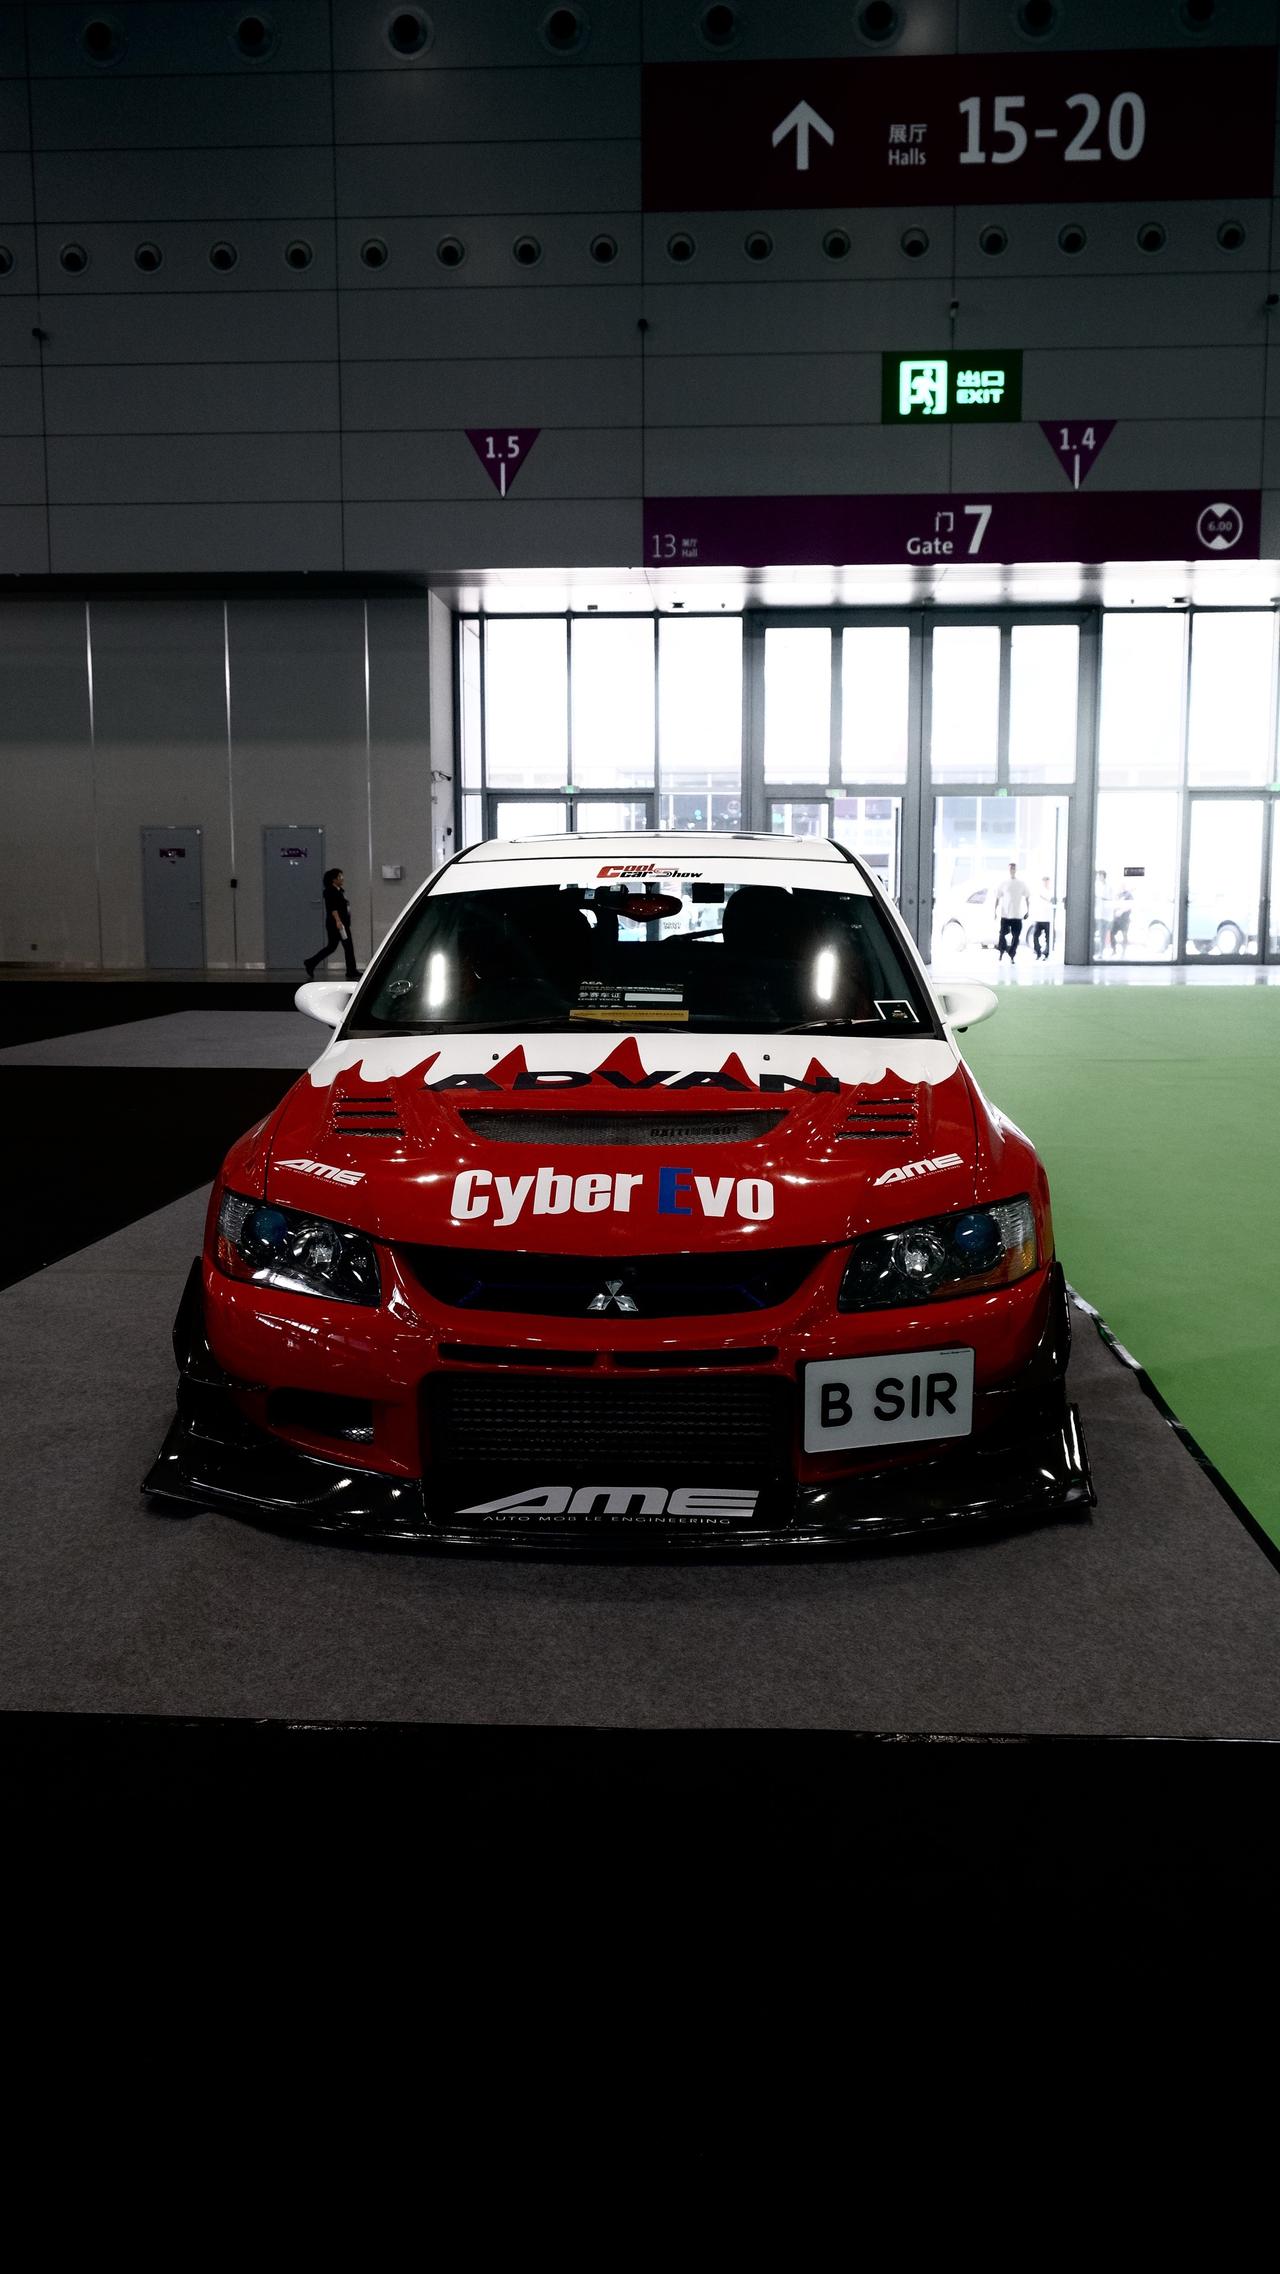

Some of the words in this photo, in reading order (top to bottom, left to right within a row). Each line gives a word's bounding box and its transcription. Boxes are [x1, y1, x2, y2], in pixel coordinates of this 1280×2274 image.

[888, 123, 927, 144] 展厅
[959, 91, 1146, 164] 15-20
[888, 148, 927, 166] Halls
[956, 370, 1005, 388] 出口
[956, 388, 1005, 404] EXIT
[486, 435, 520, 458] 1.5
[1060, 427, 1096, 450] 1.4
[906, 529, 954, 555] Gate
[964, 504, 993, 555] 7
[935, 511, 954, 532] 门
[1208, 520, 1233, 532] 6.00
[652, 533, 677, 558] 13
[427, 1070, 841, 1094] ADVAN
[274, 1159, 367, 1186] AME
[872, 1152, 965, 1187] AME
[450, 1167, 643, 1227] Cyber
[658, 1167, 775, 1220] Evo
[821, 1382, 853, 1428] B
[874, 1372, 958, 1422] SIR
[454, 1486, 760, 1518] AME
[611, 1516, 731, 1525] ENGINEERING
